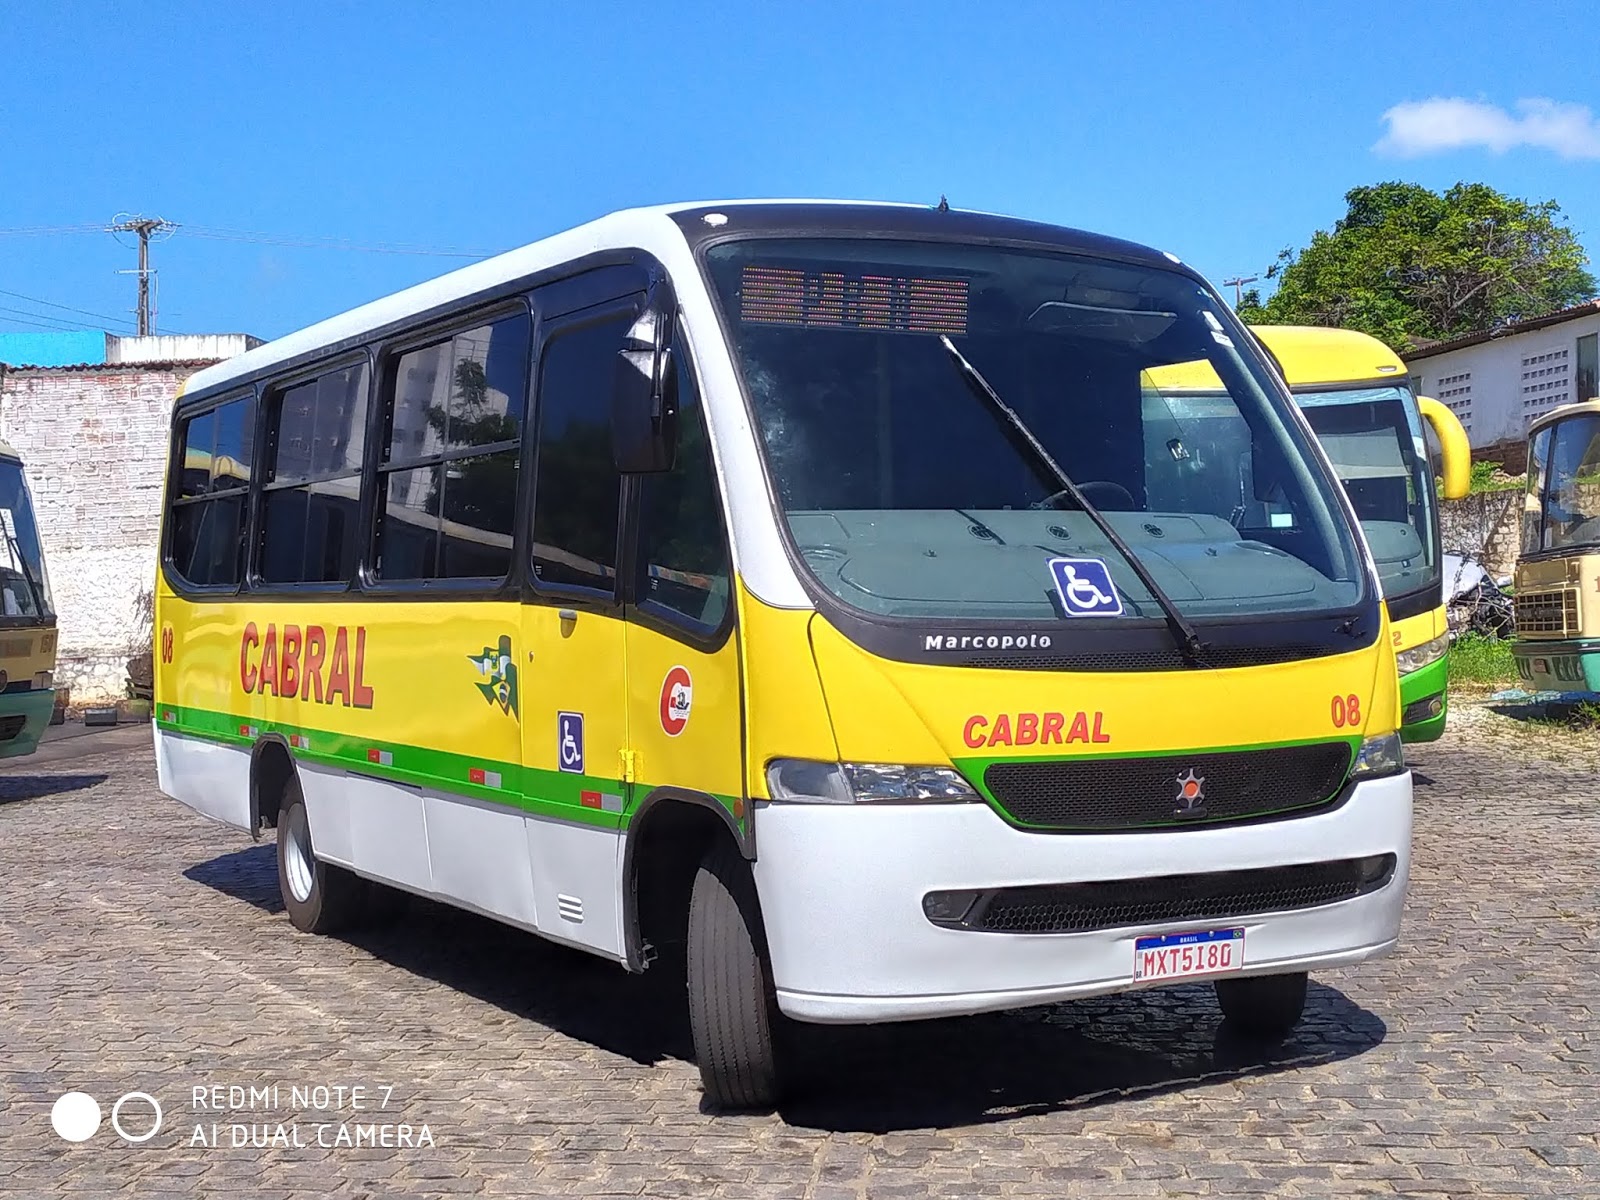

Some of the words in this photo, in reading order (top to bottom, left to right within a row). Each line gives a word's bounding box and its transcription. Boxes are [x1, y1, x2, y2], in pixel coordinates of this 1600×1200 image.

[162, 627, 173, 664] 08
[925, 634, 1052, 651] Marcopolo
[240, 621, 374, 709] CABRAL
[1331, 694, 1361, 727] 08
[963, 711, 1111, 748] CABRAL
